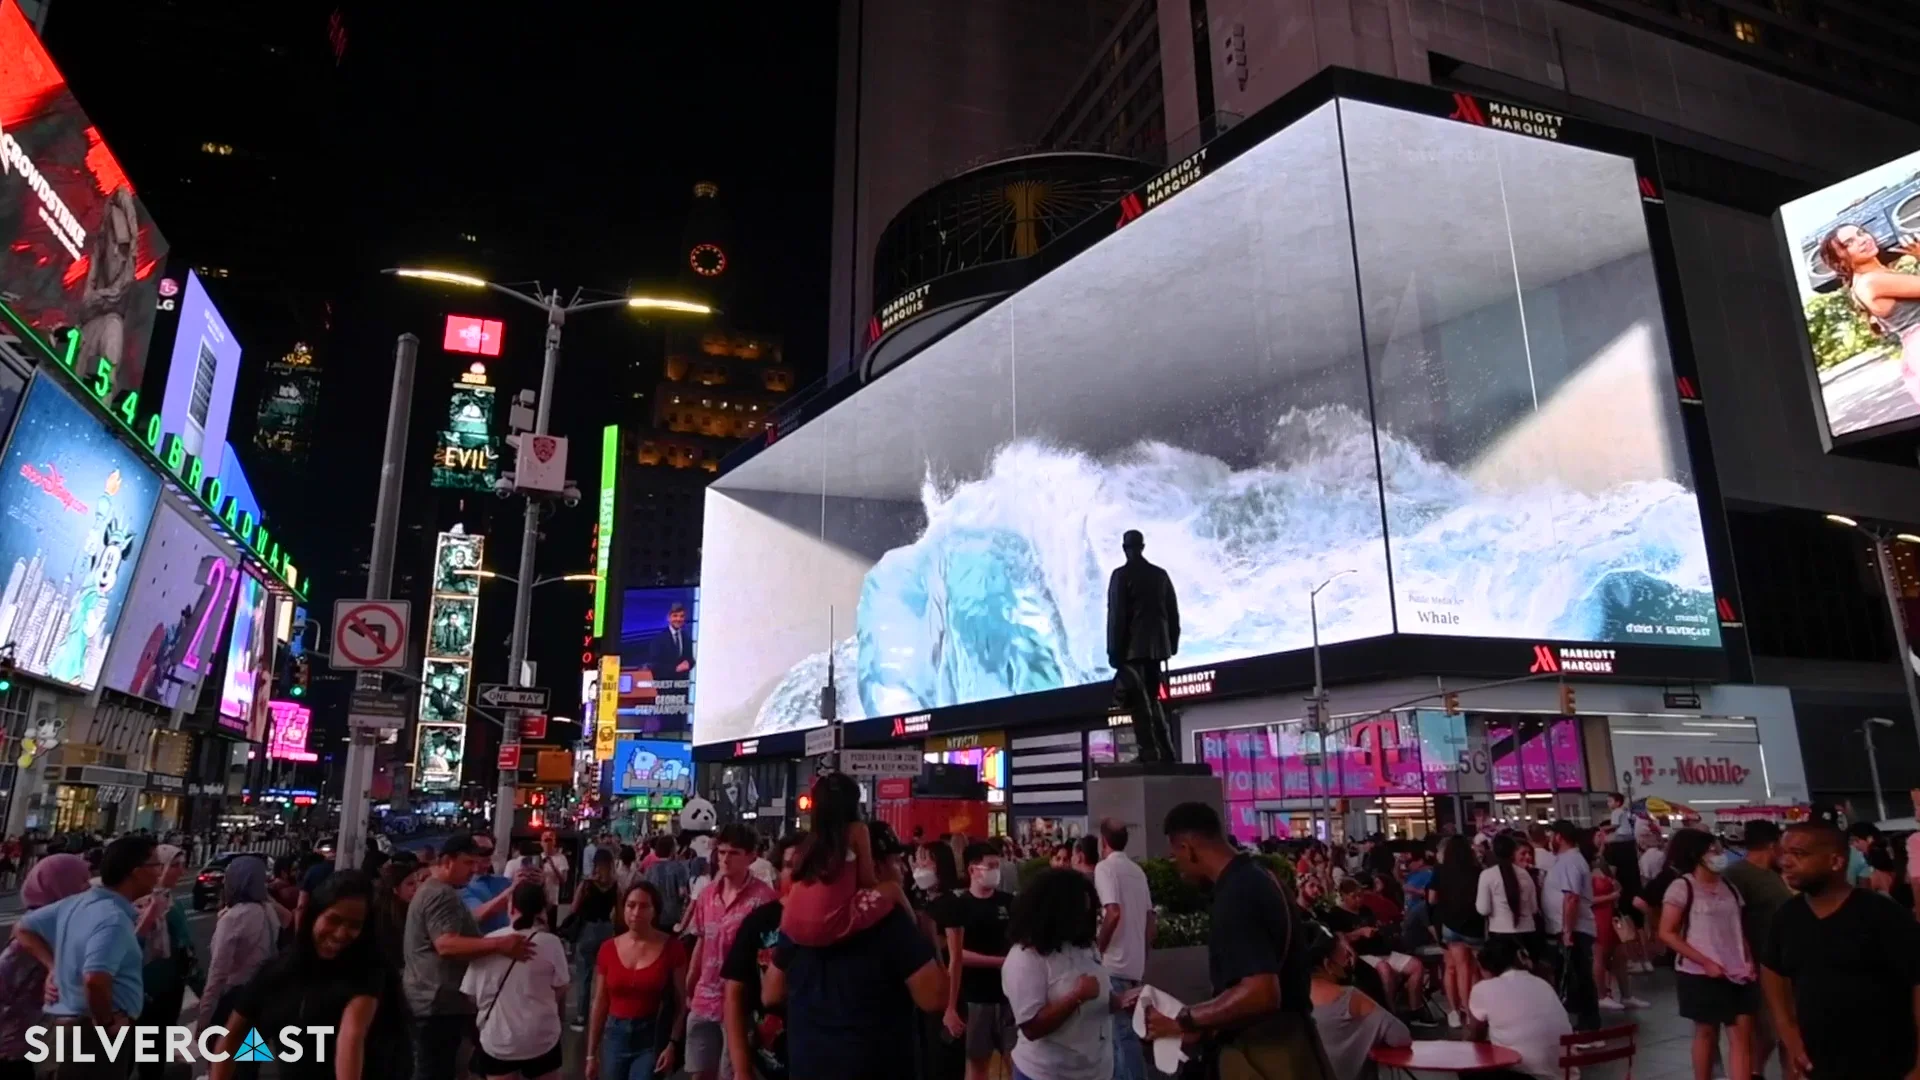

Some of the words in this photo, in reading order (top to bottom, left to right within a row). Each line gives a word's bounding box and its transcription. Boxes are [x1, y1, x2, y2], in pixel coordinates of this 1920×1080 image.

[1489, 102, 1563, 127] MARRIOTT
[1491, 116, 1558, 139] MARQUIS
[1146, 148, 1208, 194] MARRIOTT
[3, 133, 87, 248] CROWDSTRIKE
[1147, 166, 1201, 207] MARQUIS
[156, 299, 175, 311] LG
[882, 284, 930, 319] MARRIOTT
[882, 300, 923, 331] MARQUIS
[64, 328, 162, 447] 1540
[167, 436, 293, 579] BROADWAY
[444, 446, 488, 470] EVIL
[1417, 610, 1460, 625] Whale
[1560, 648, 1616, 660] MARRIOTT
[1169, 670, 1216, 686] MARRIOTT
[1561, 661, 1613, 673] MARQUIS
[488, 691, 509, 701] ONE
[518, 693, 542, 702] WAY
[1169, 682, 1212, 697] MARQUIS
[1458, 750, 1488, 775] 5G
